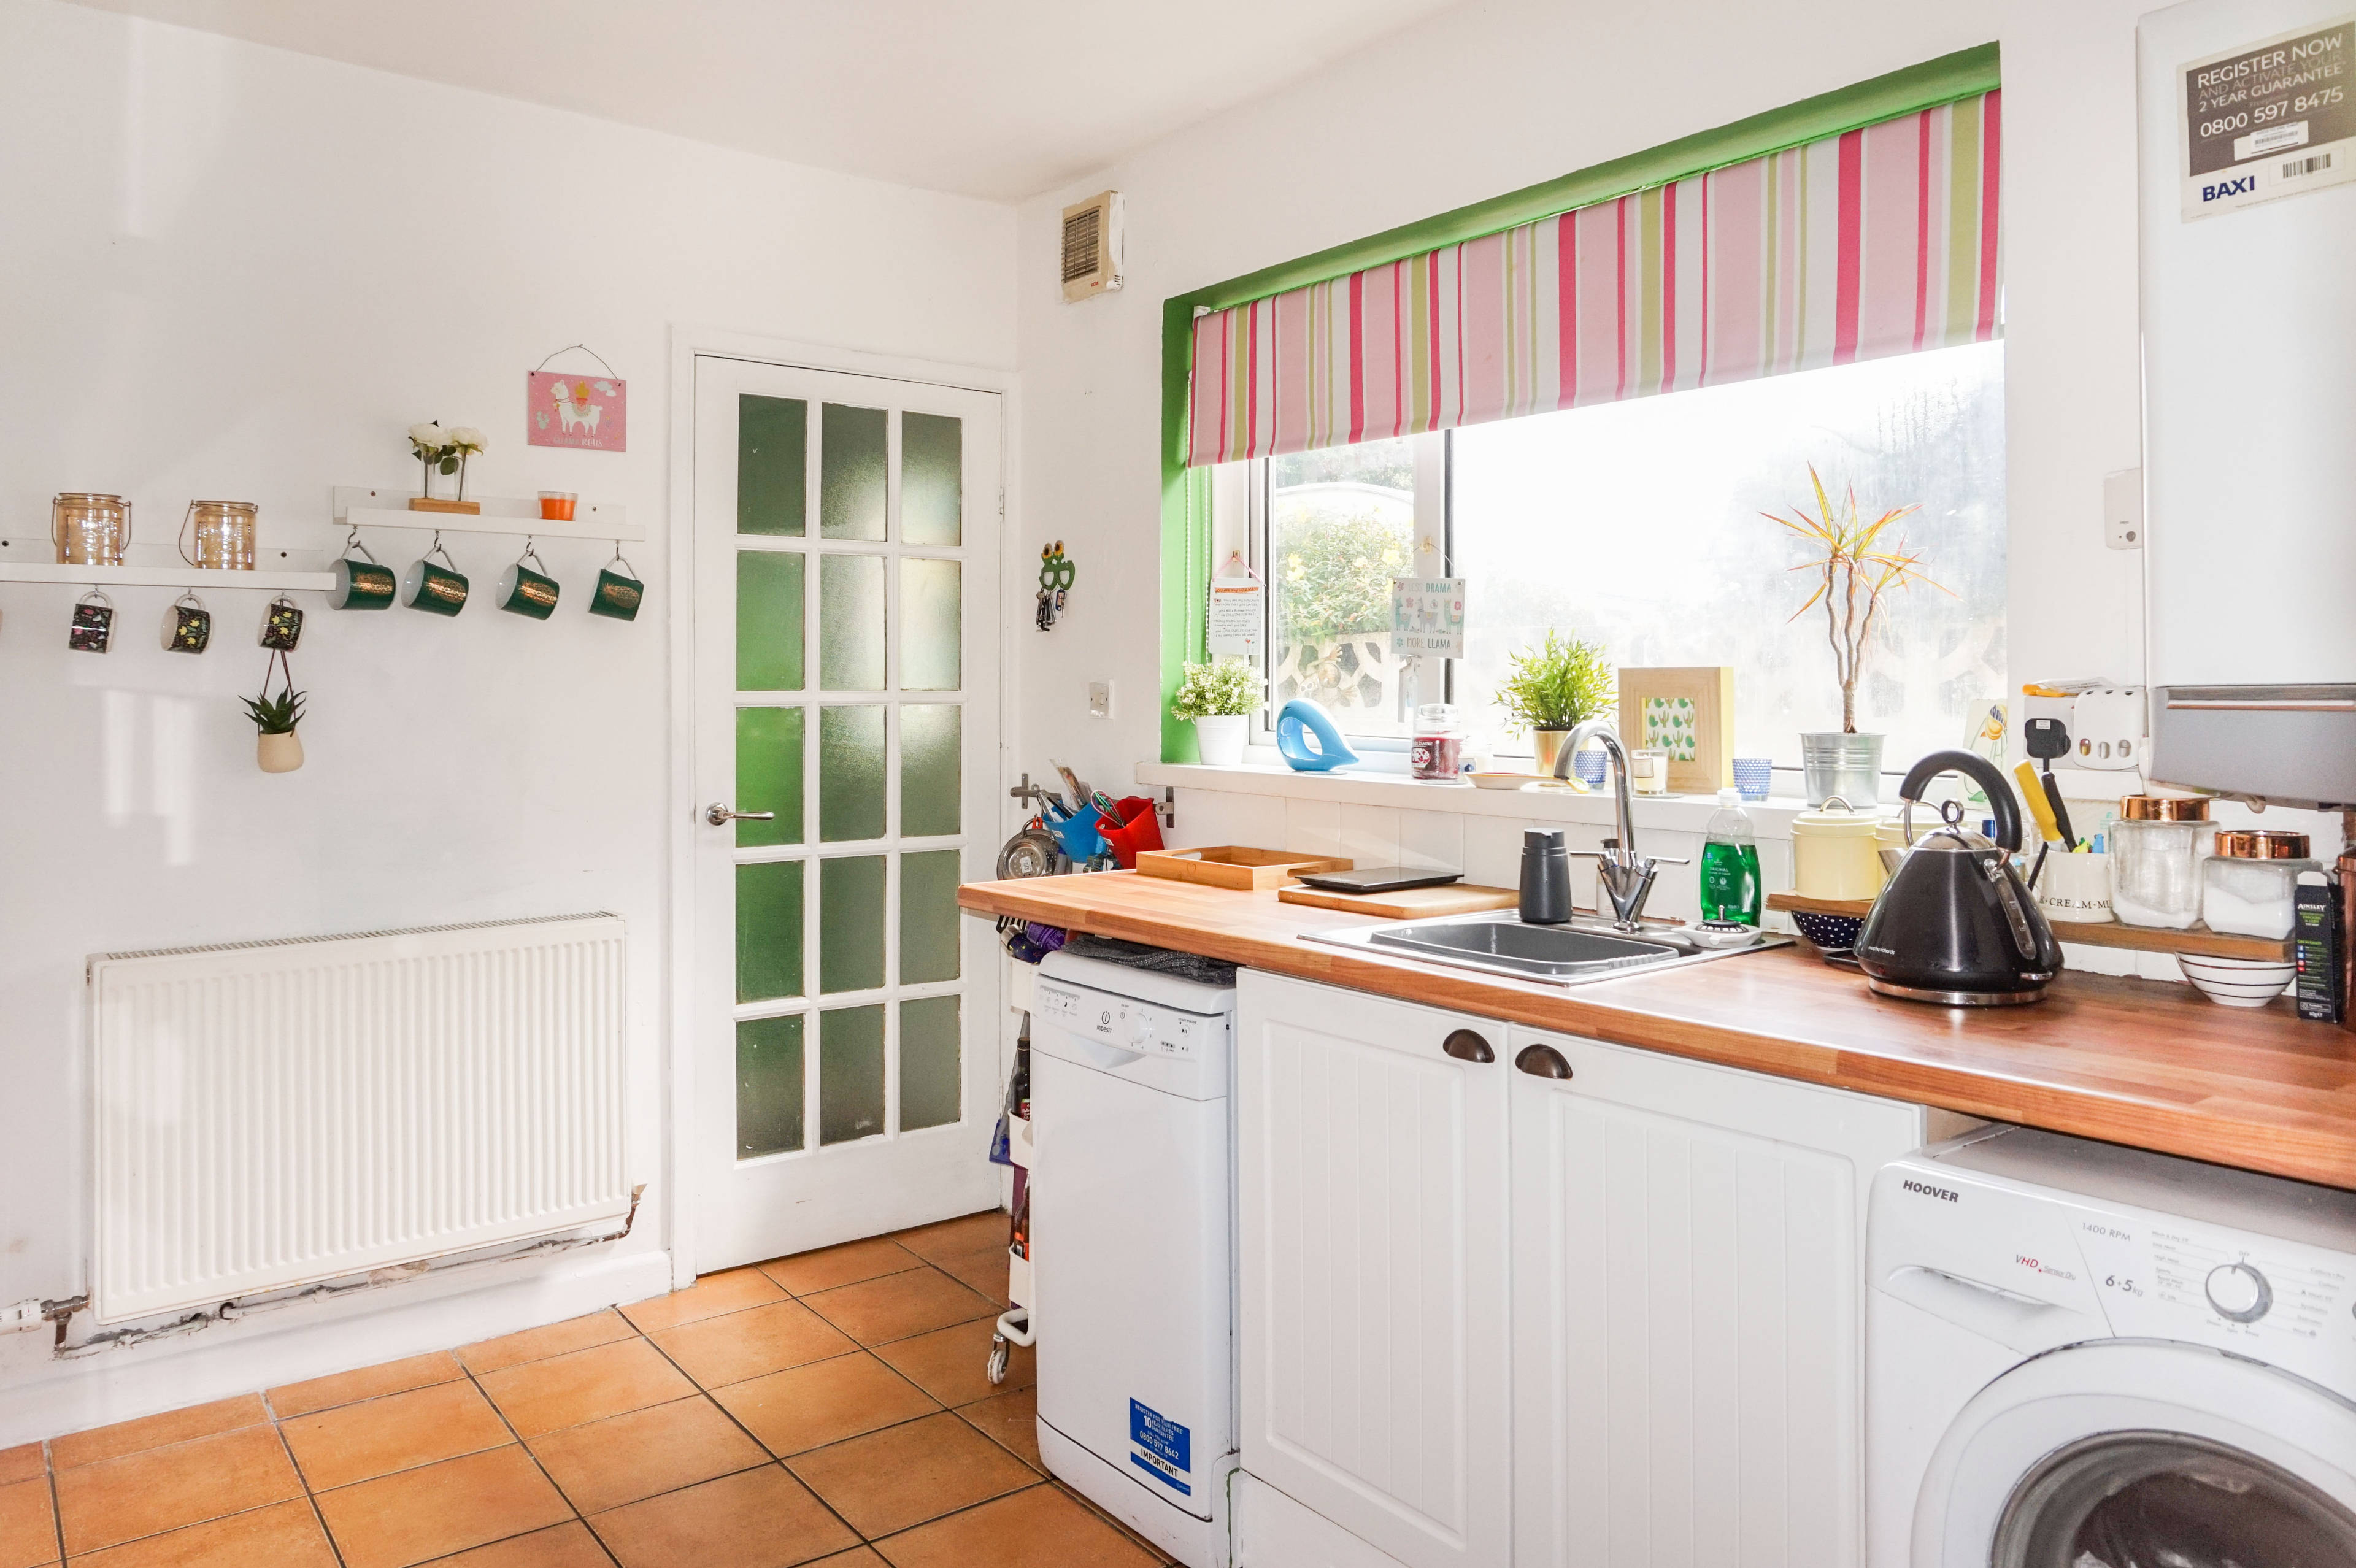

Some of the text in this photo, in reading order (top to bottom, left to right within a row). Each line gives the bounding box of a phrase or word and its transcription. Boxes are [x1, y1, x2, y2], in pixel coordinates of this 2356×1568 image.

[2198, 33, 2343, 88] REGISTER NOW
[2199, 83, 2228, 100] AND
[2233, 62, 2296, 91] ACTIVATE
[2199, 101, 2207, 112] 2
[2211, 90, 2247, 109] YEAR
[2251, 61, 2344, 97] GUARANTEE
[2200, 112, 2248, 137] 0800
[2254, 101, 2288, 123] 597
[2294, 86, 2344, 112] 8475
[2202, 175, 2255, 202] BAXI
[1426, 582, 1452, 594] DRAMA
[1407, 638, 1451, 650] MORE LLAMA
[2049, 898, 2092, 909] CREAM
[2297, 903, 2327, 912] AINSLEY
[1096, 1025, 1112, 1034] INDESIT
[1903, 1179, 1959, 1203] HOOVER
[2082, 1222, 2131, 1242] 1400 RPM
[2015, 1254, 2039, 1268] VHD
[2043, 1265, 2063, 1277] Sensor
[1135, 1404, 1153, 1418] REGISTER
[1144, 1415, 1152, 1429] 10
[1152, 1426, 1174, 1442] GUARANTEE
[1140, 1430, 1153, 1444] 0800
[1154, 1439, 1163, 1451] 597
[1165, 1445, 1179, 1460] 8642
[1141, 1448, 1178, 1477] IMPORTANT
